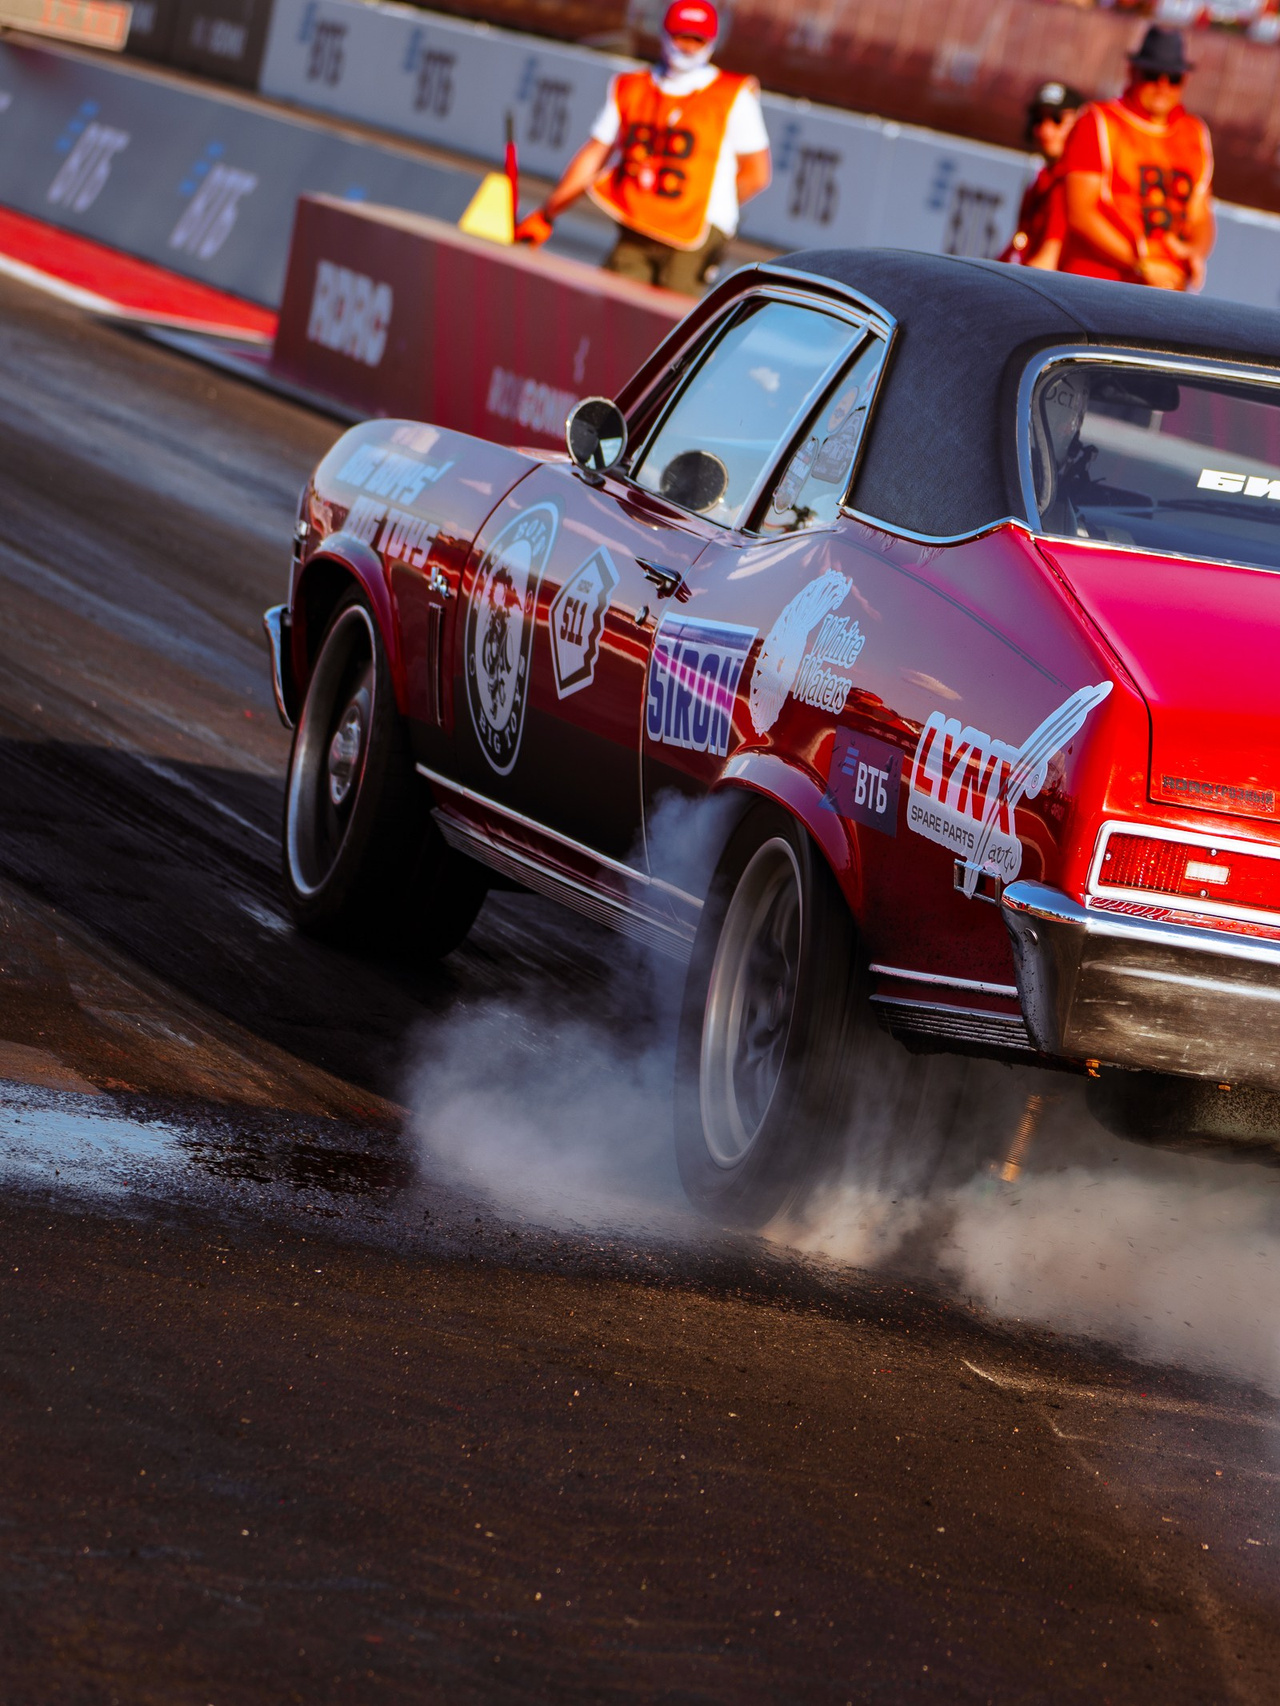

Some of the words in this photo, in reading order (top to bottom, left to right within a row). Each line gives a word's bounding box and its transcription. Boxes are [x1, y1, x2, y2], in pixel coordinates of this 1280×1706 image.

[336, 443, 388, 488] BIG
[341, 495, 389, 545] BIG
[377, 508, 441, 569] TOYS
[560, 596, 583, 647] 511
[813, 615, 864, 668] White
[648, 643, 744, 749] SIRON
[794, 656, 852, 713] Waters
[854, 761, 889, 815] ВТБ
[914, 726, 1012, 836] LYNX
[911, 804, 942, 833] SPARE
[942, 820, 975, 850] PARTS
